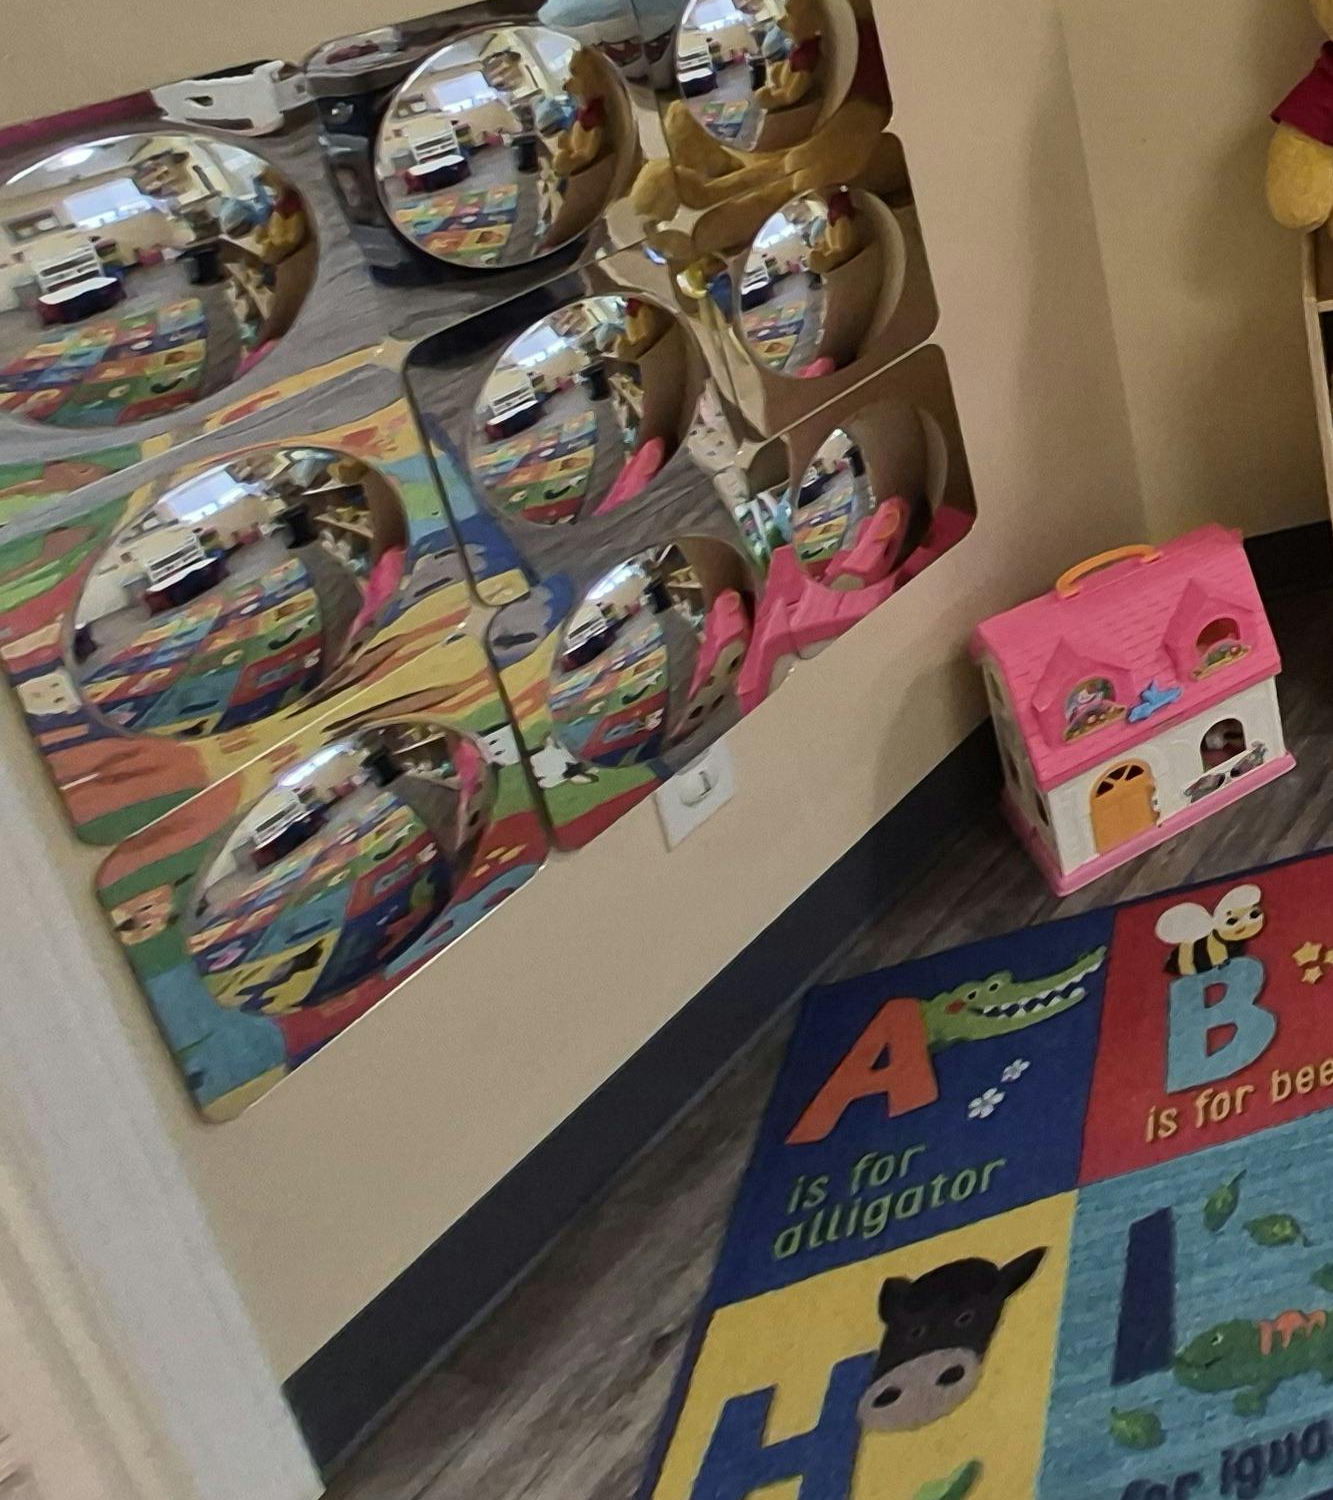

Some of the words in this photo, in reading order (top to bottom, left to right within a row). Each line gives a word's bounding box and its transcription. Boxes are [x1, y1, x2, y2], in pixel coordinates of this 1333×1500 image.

[785, 997, 940, 1145] A
[1166, 955, 1279, 1095] B
[1145, 1104, 1178, 1143] is
[1195, 1083, 1256, 1129] for
[772, 1156, 1007, 1261] alligator
[787, 1173, 830, 1216] is
[851, 1143, 926, 1195] for
